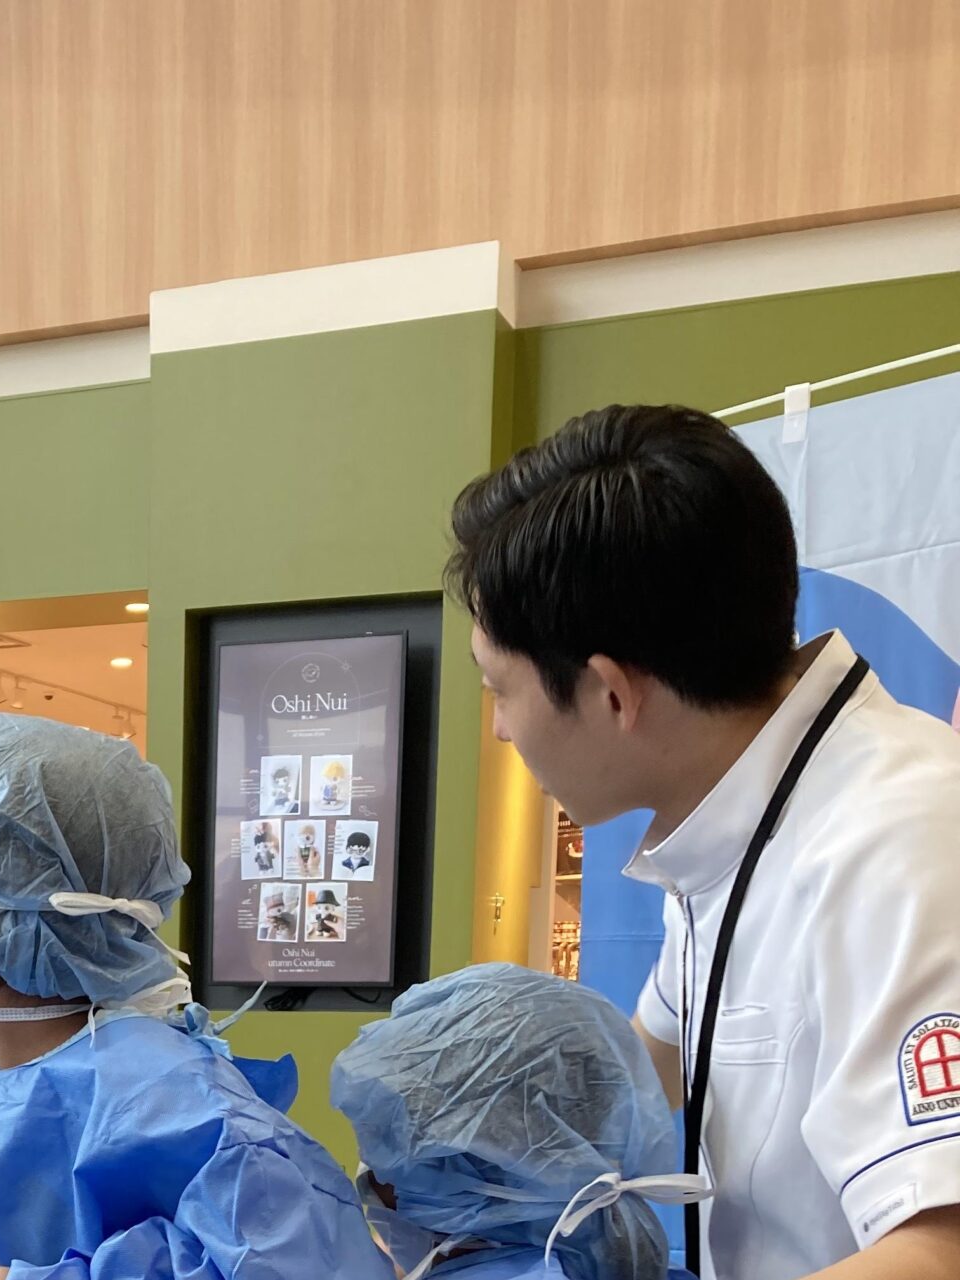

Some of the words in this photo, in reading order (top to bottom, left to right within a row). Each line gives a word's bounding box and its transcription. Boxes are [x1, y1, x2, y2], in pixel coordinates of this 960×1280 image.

[271, 694, 312, 713] Oshi
[315, 692, 348, 711] Nui
[301, 948, 315, 957] Nui
